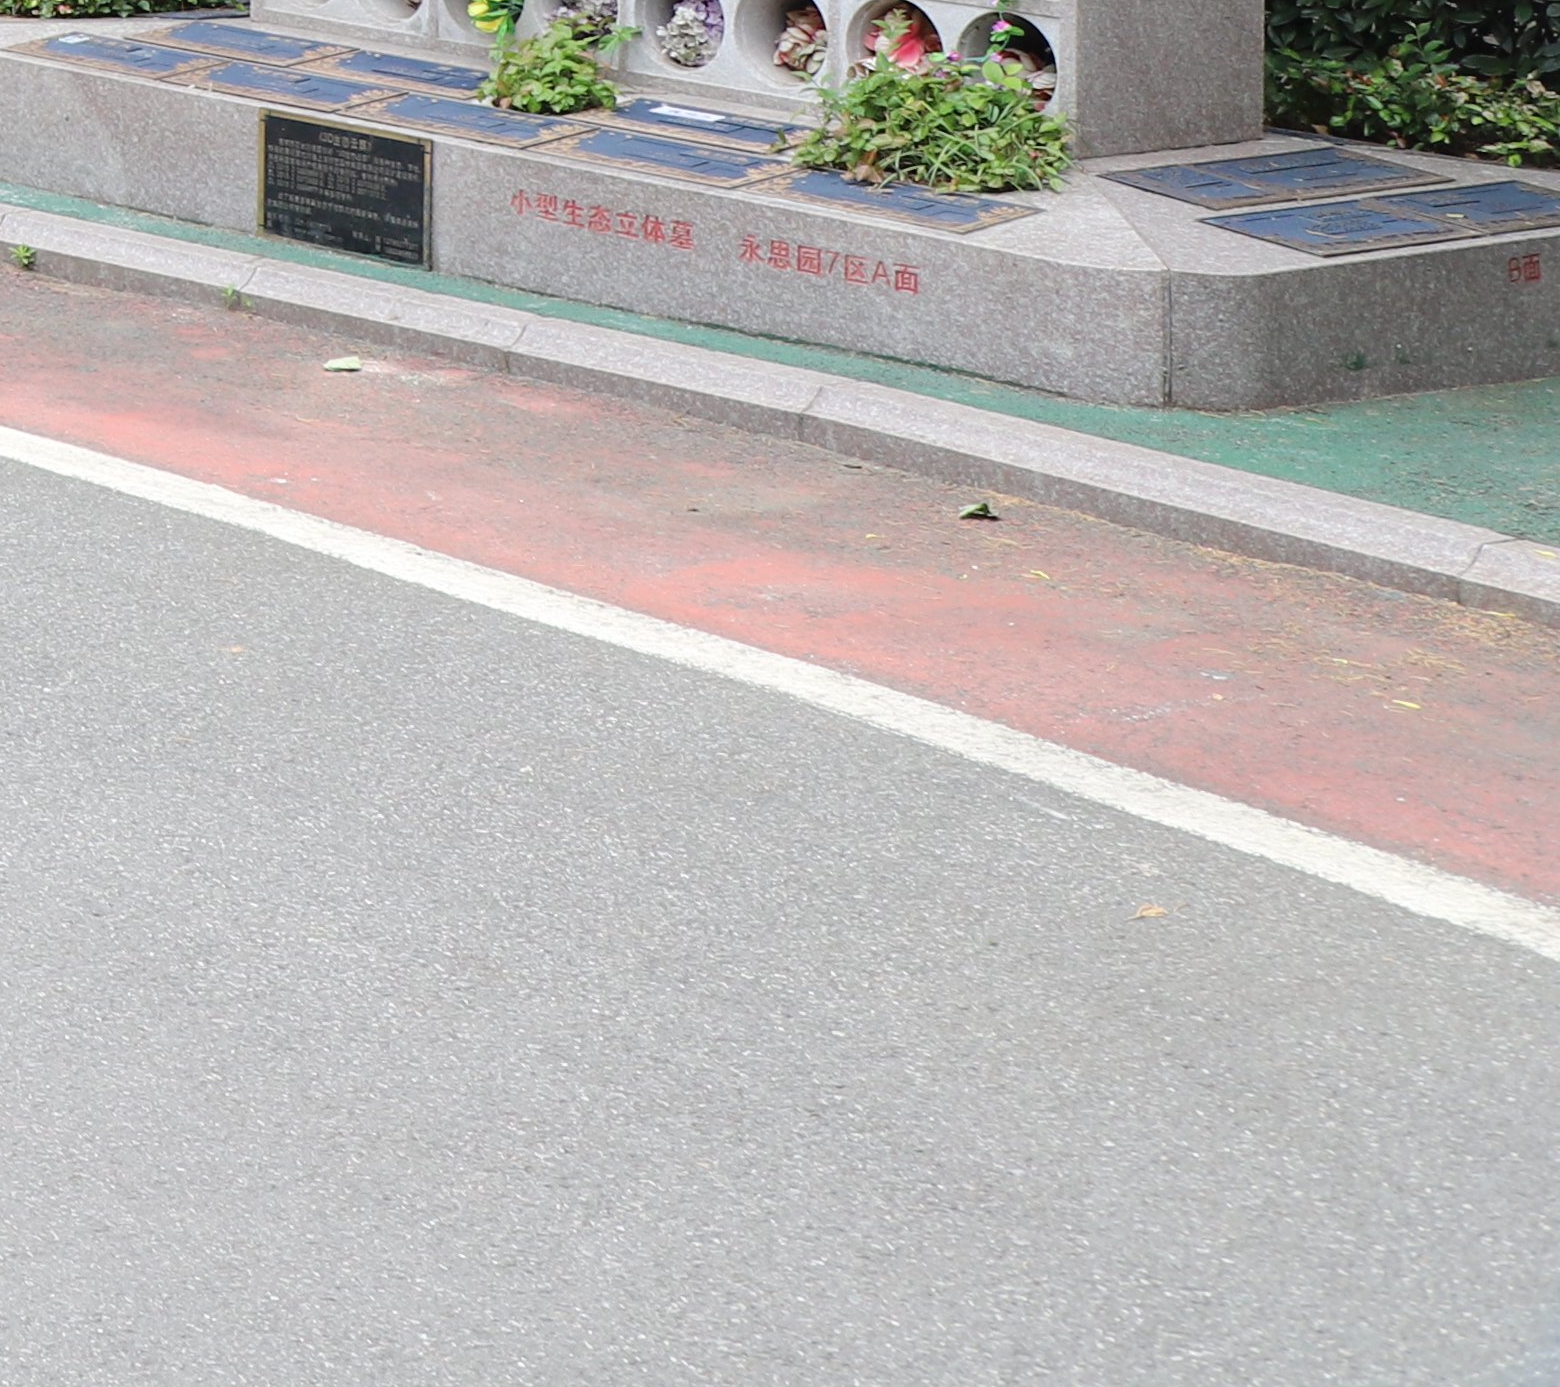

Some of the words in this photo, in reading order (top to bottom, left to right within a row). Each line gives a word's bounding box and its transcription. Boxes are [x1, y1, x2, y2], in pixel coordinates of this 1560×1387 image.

[510, 189, 694, 250] 小型生态立体墓
[739, 234, 920, 294] 永思园7区A面
